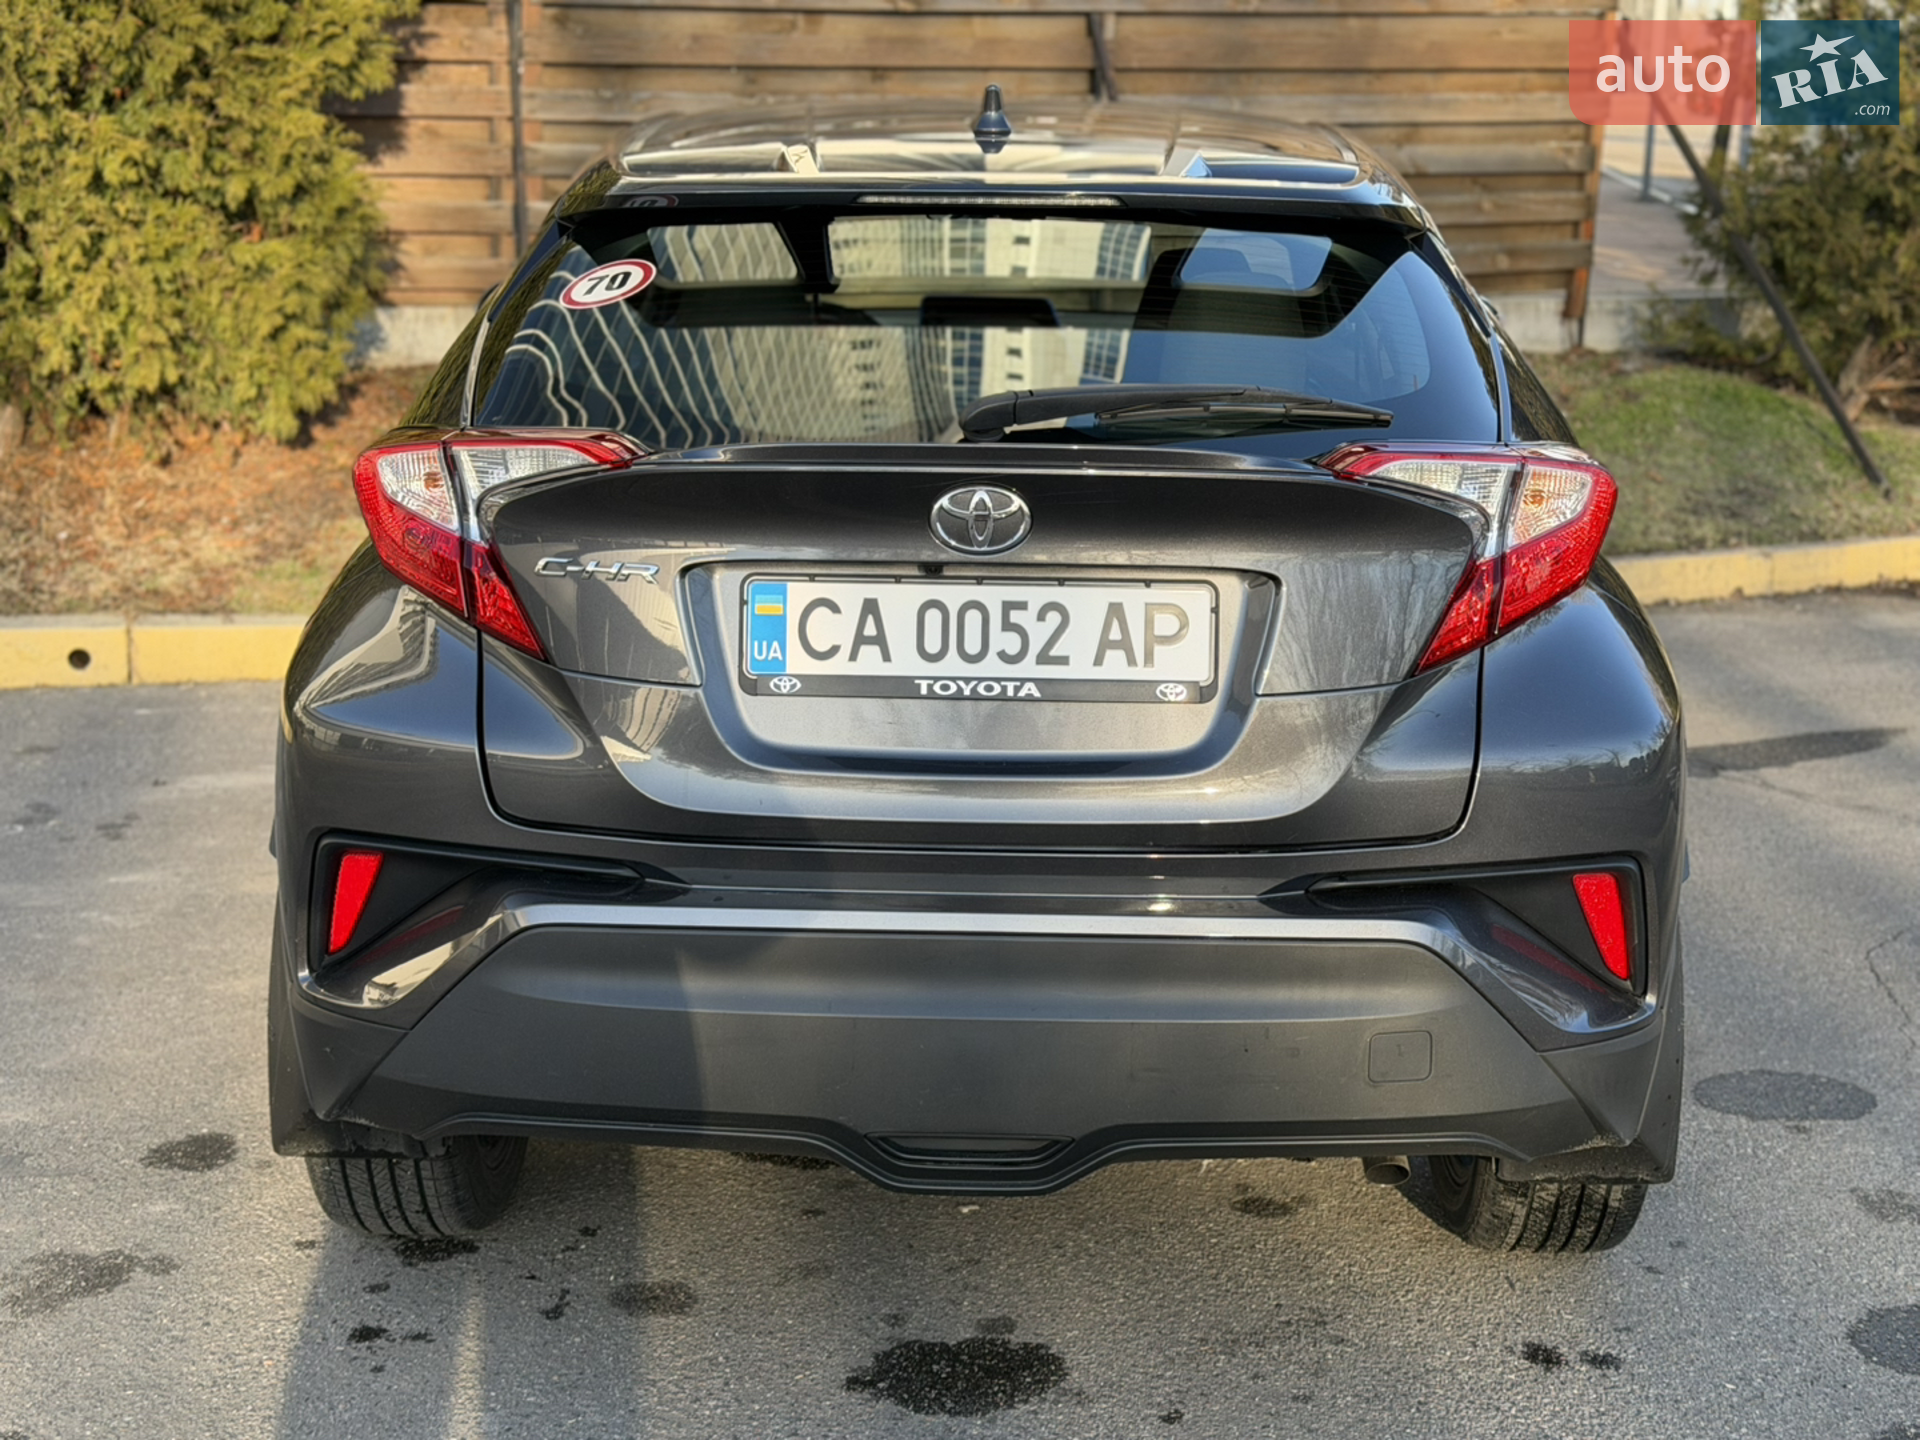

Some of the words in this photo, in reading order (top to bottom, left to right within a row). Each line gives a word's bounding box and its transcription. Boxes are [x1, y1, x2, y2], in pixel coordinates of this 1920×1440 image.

[583, 271, 632, 296] 70
[534, 557, 660, 584] C-HR
[798, 597, 892, 662] CA
[916, 599, 1071, 666] 0052
[1093, 602, 1190, 668] AP
[753, 640, 783, 661] UA
[914, 679, 1042, 698] TOYOTA
